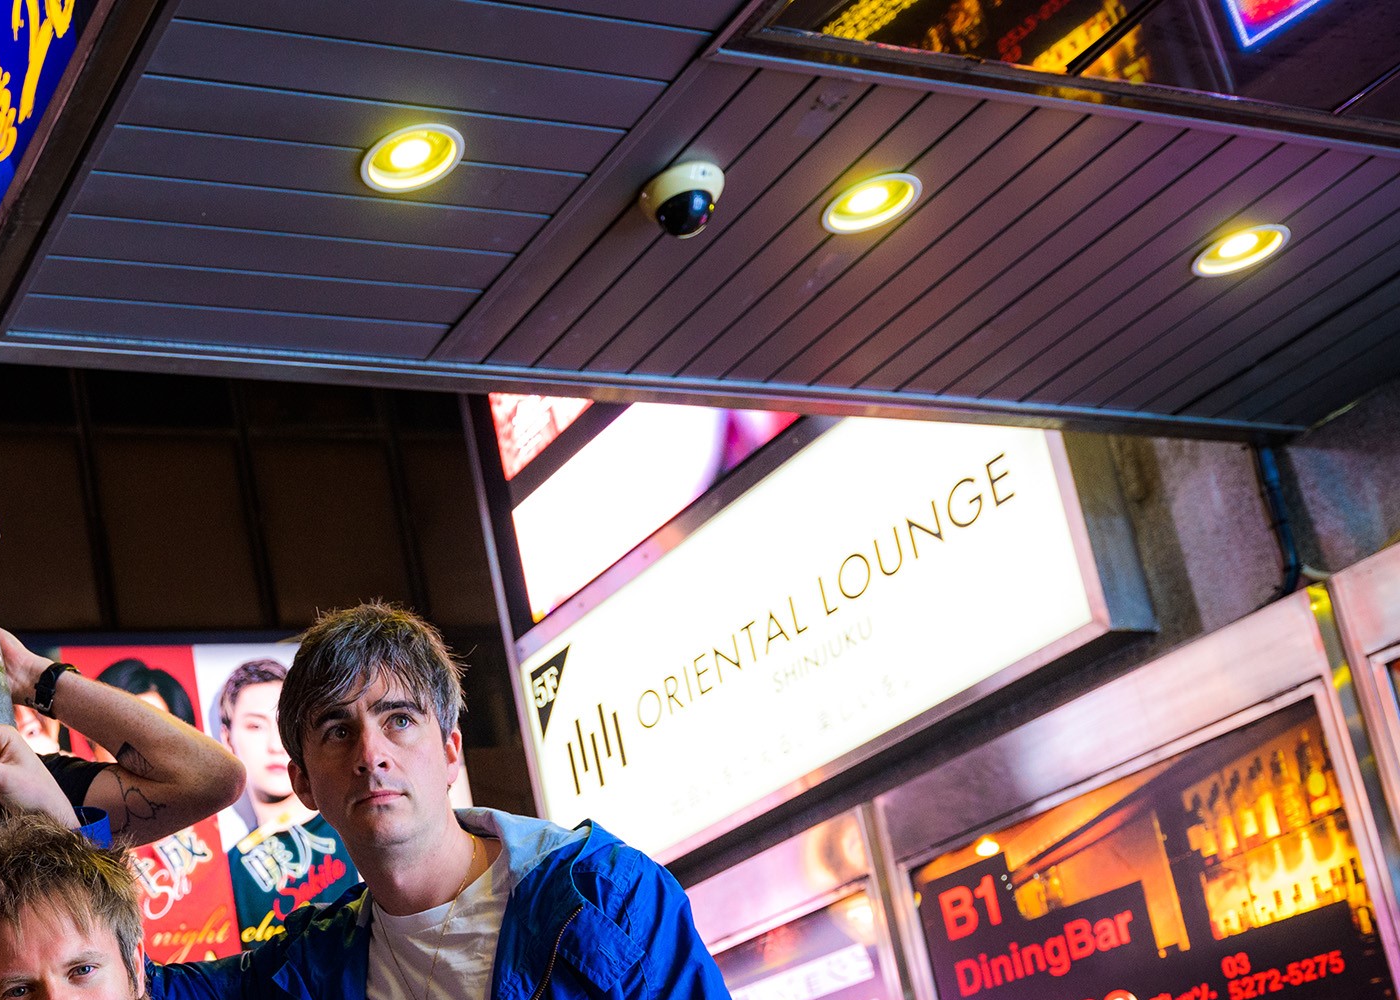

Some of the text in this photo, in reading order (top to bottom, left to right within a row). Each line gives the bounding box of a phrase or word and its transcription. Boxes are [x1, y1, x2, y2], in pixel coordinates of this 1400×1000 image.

[636, 452, 1017, 729] ORIENTAL LOUNGE
[532, 665, 560, 709] 5F
[771, 616, 874, 695] SHINJUKU
[152, 905, 232, 964] night
[938, 873, 1003, 942] B1
[953, 908, 1134, 998] DiningBar
[1220, 951, 1252, 979] 03
